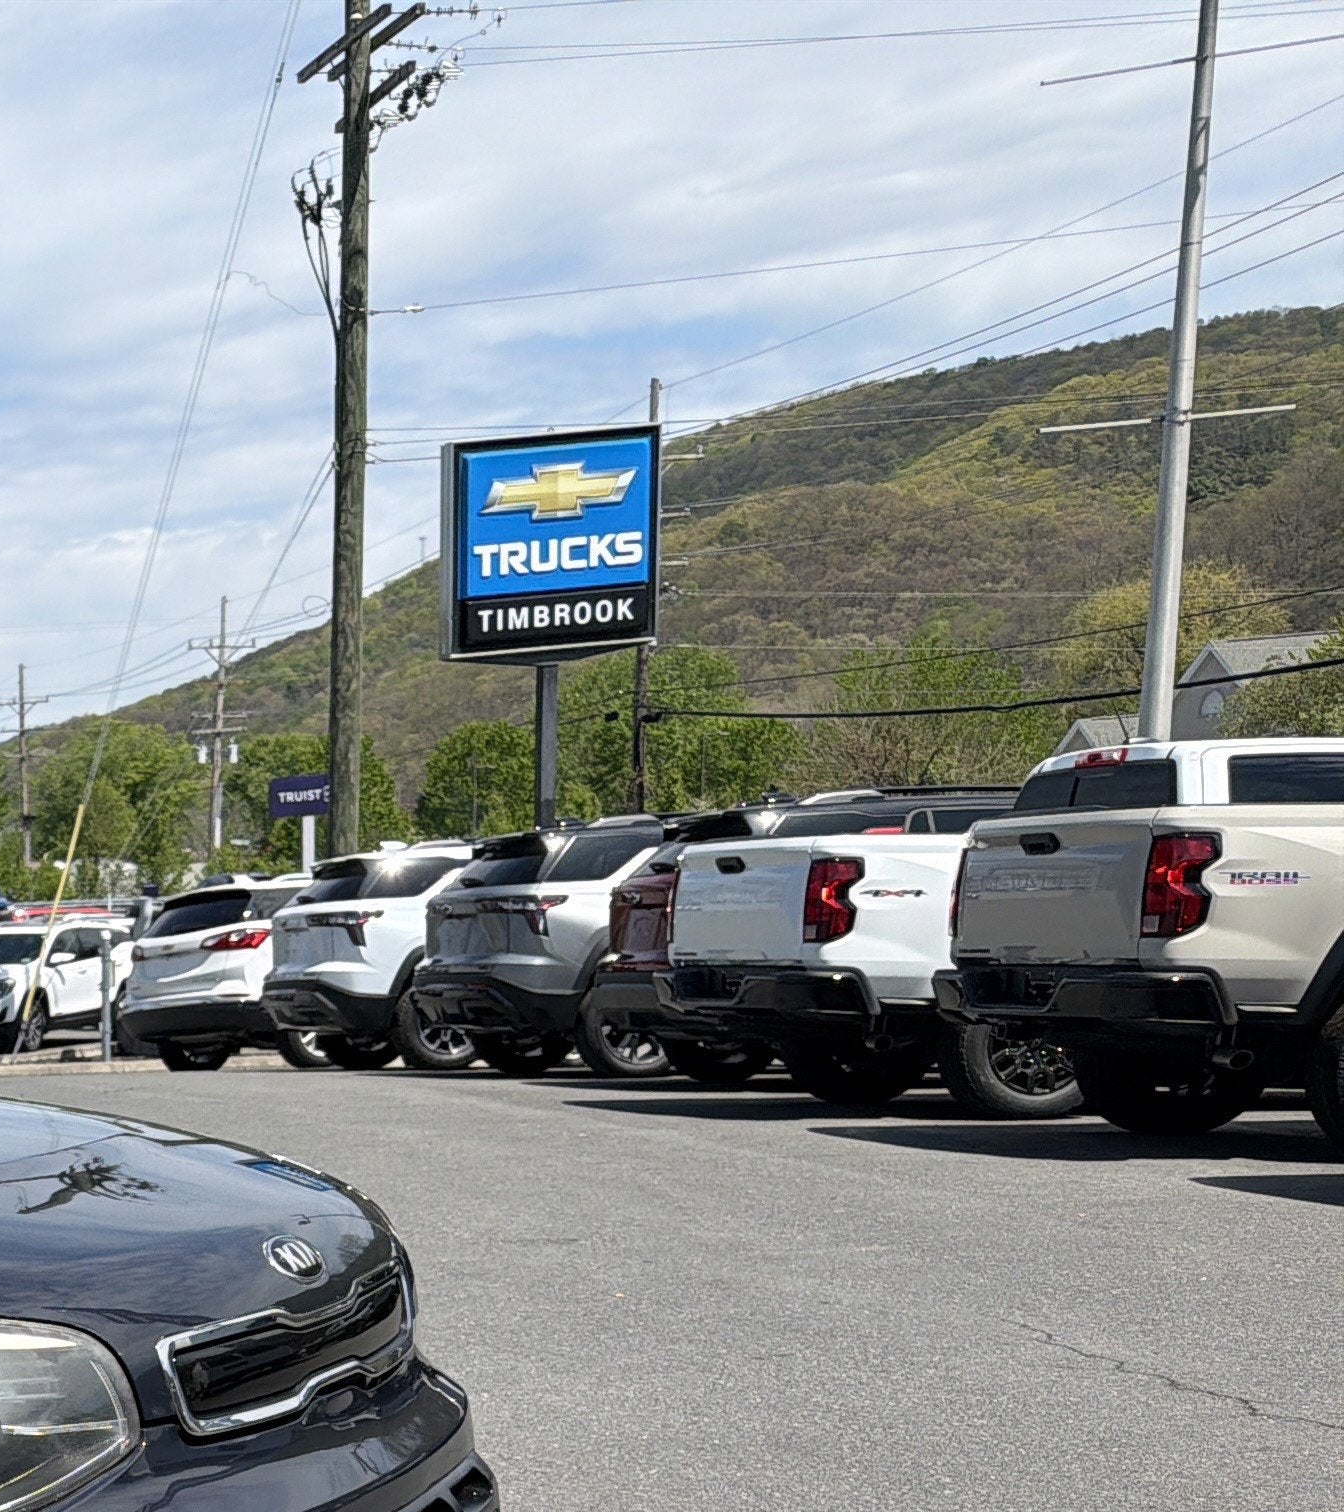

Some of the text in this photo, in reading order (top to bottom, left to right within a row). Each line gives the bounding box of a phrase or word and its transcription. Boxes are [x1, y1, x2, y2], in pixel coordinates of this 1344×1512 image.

[473, 531, 643, 577] TRUCKS
[478, 598, 635, 633] TIMBROOK
[277, 789, 322, 804] TRUIST
